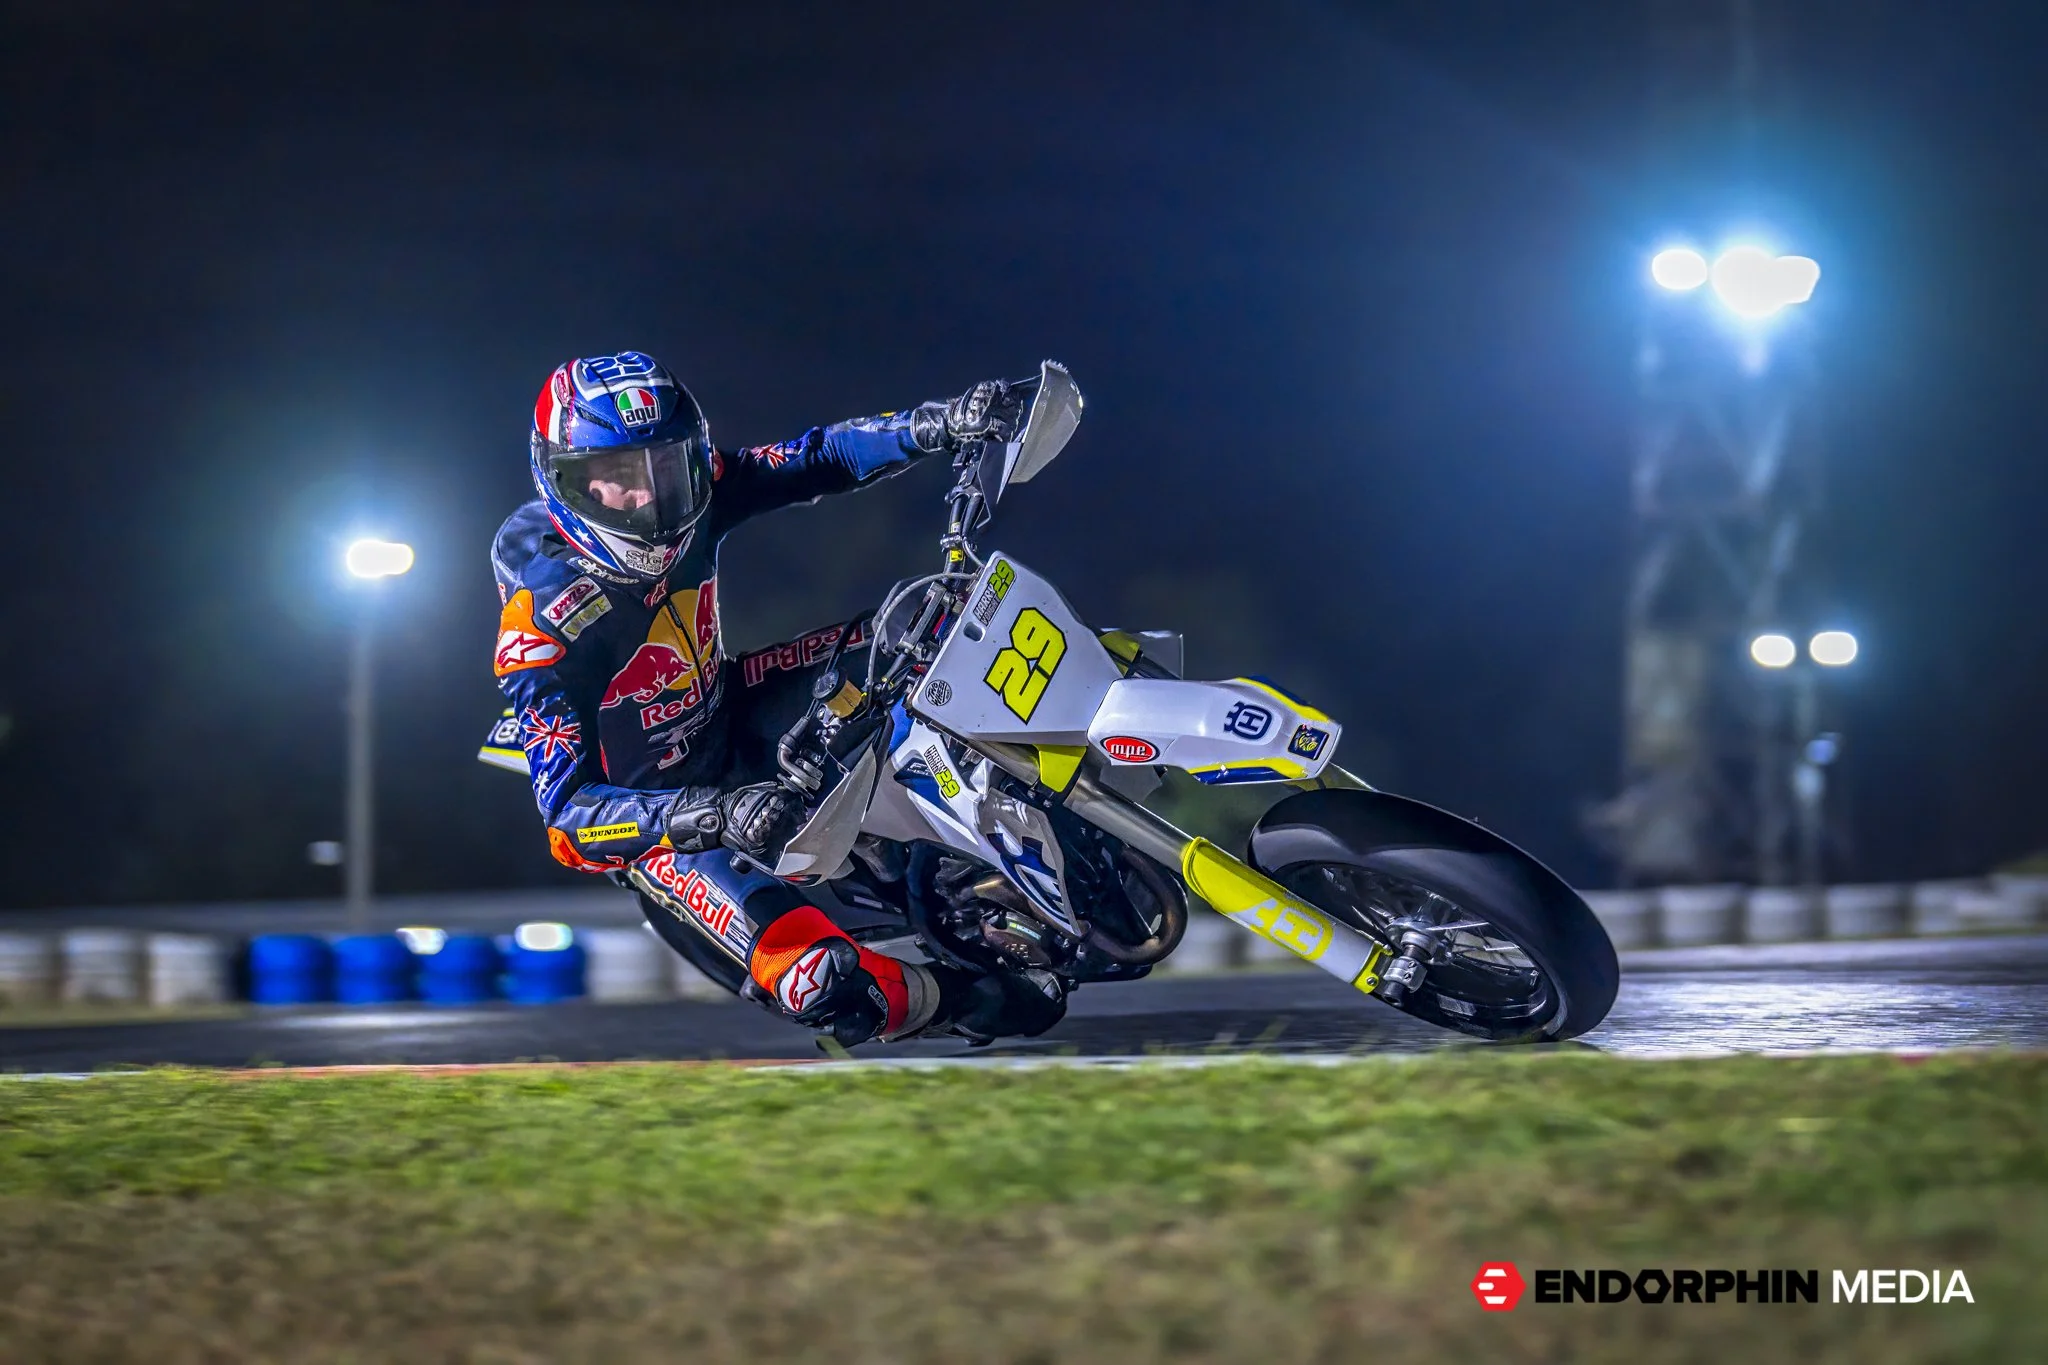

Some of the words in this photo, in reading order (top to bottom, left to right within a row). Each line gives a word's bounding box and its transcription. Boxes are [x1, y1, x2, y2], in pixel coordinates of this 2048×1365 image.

[625, 406, 656, 423] agv
[987, 559, 1016, 600] 29
[983, 607, 1068, 726] 29
[640, 677, 703, 730] Red
[1110, 742, 1147, 758] mpe
[935, 768, 961, 799] 29
[588, 826, 637, 839] DUNLOP
[645, 852, 697, 899] Red
[686, 878, 735, 936] Bull
